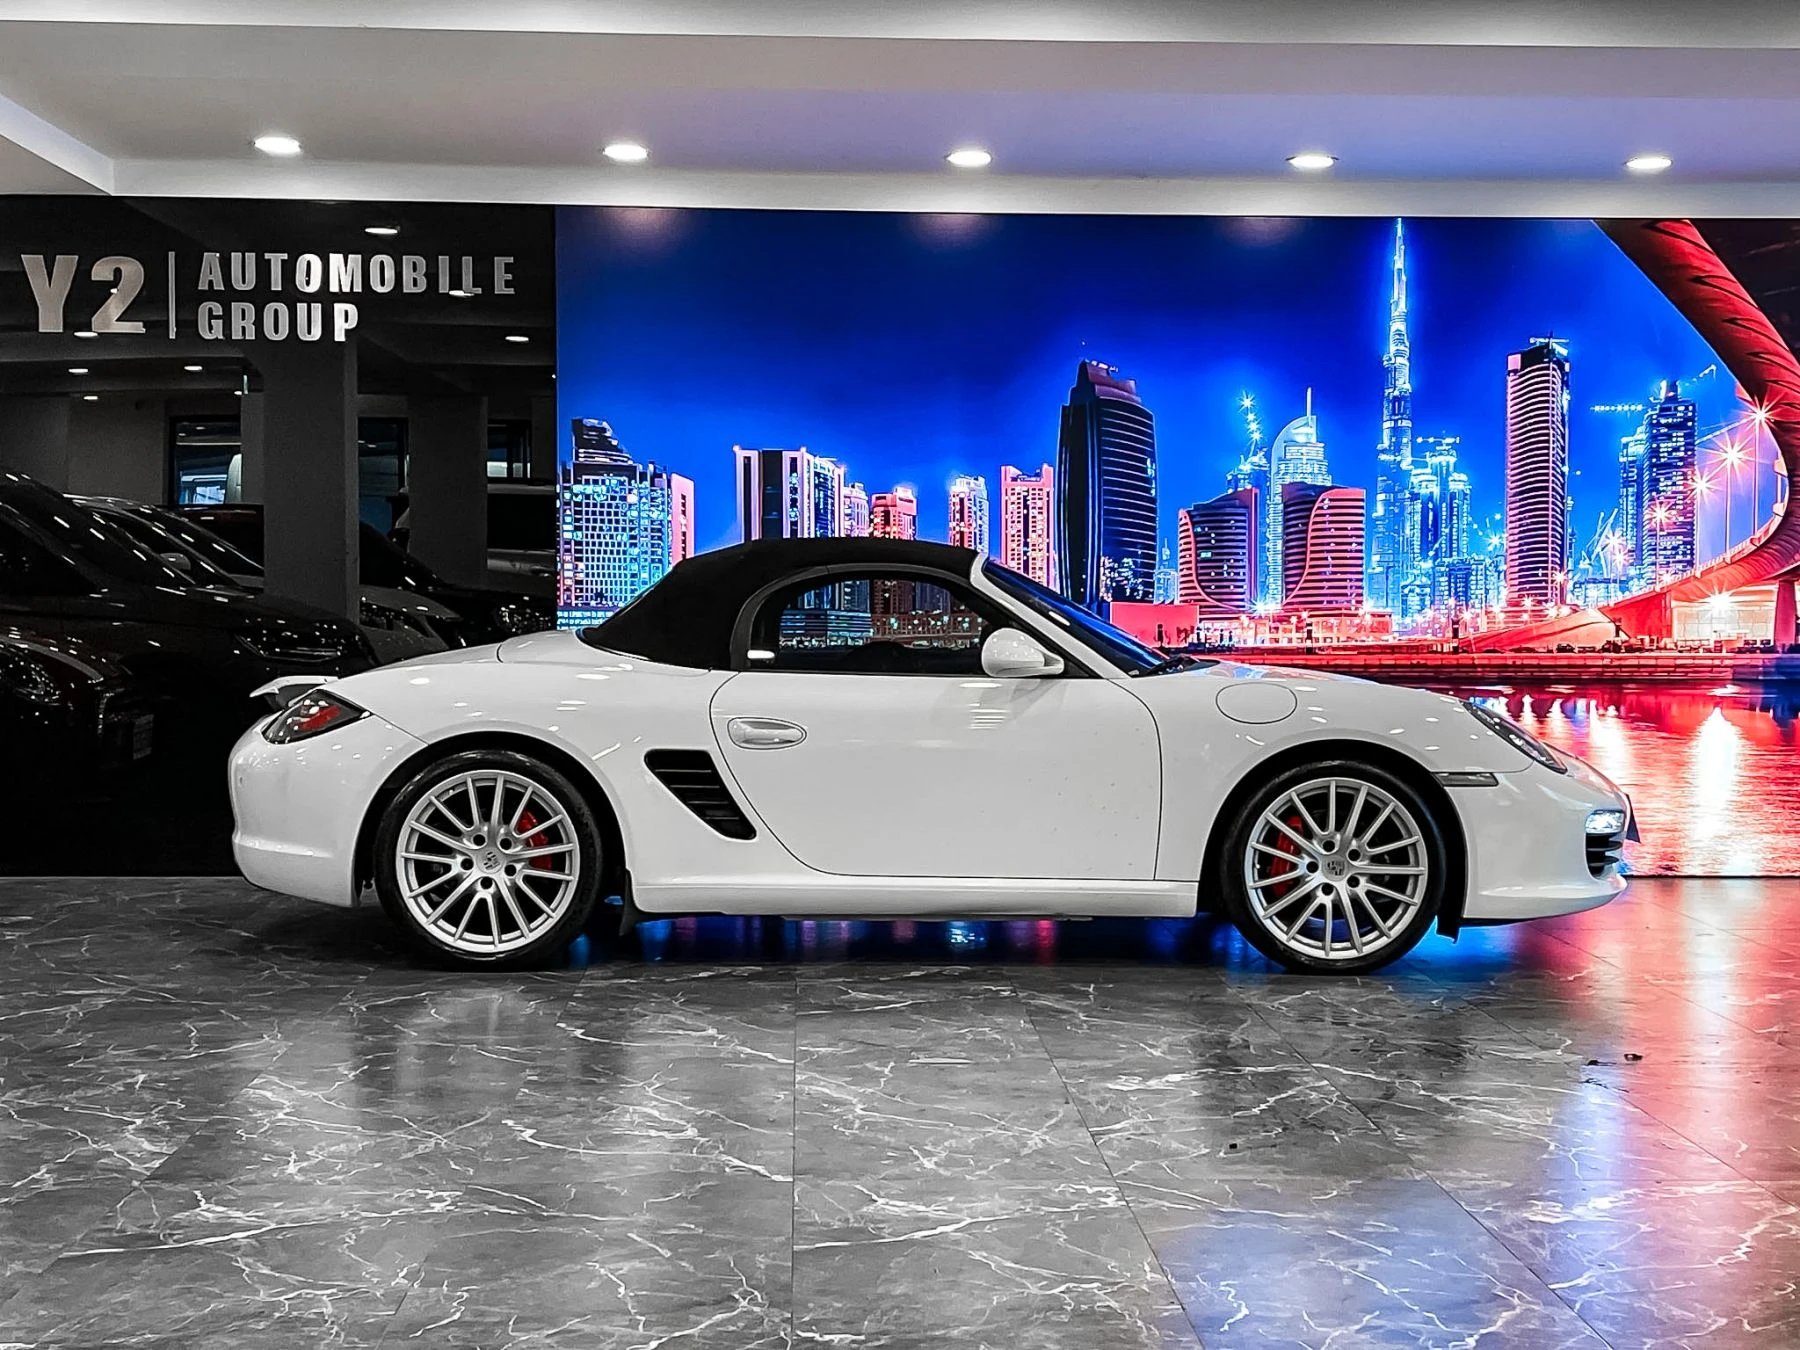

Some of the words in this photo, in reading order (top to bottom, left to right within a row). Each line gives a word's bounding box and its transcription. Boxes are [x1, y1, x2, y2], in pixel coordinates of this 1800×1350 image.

[21, 254, 146, 333] Y2
[198, 252, 516, 295] AUTOMOBILE
[198, 302, 359, 342] GROUP
